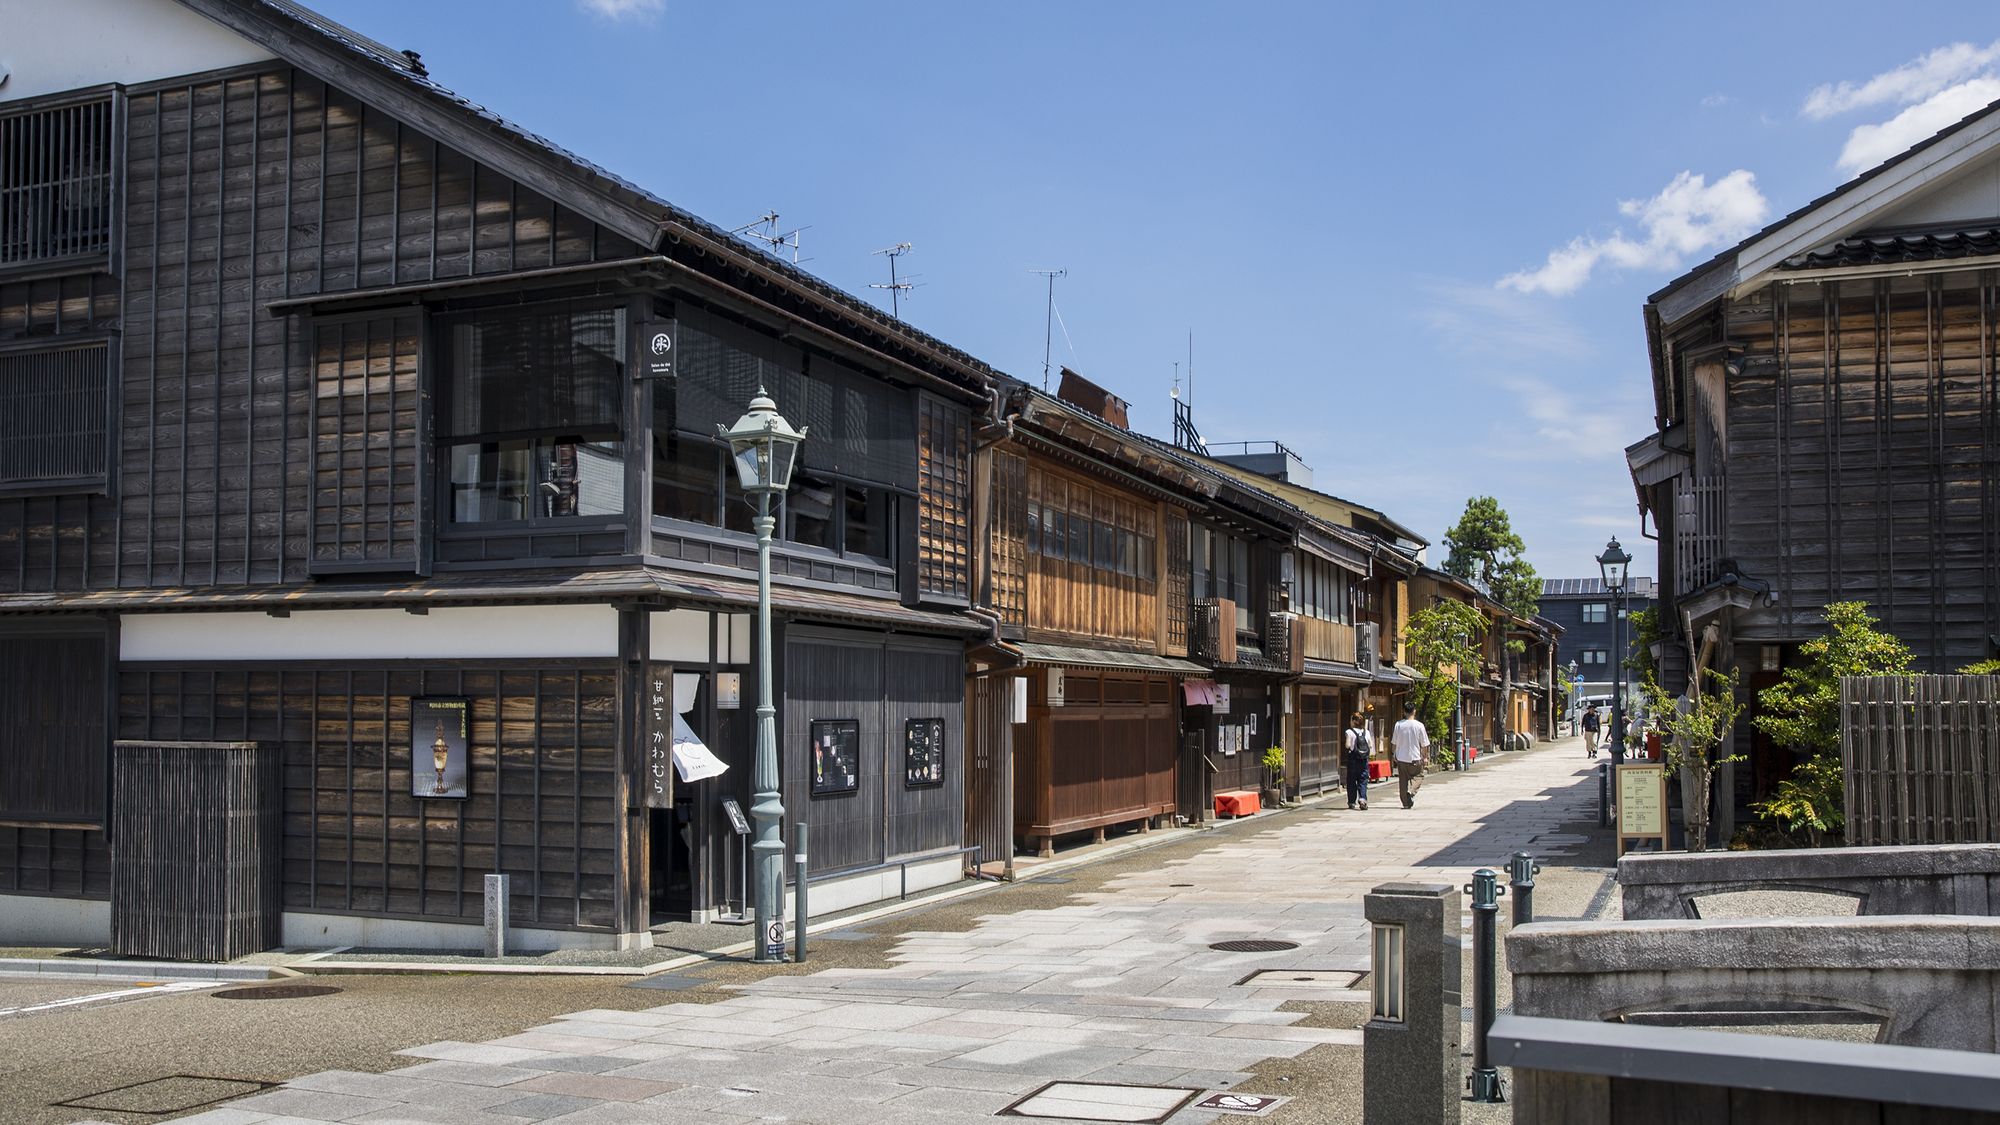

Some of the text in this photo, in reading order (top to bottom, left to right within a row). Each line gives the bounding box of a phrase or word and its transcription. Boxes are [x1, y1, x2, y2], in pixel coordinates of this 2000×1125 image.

[652, 679, 665, 794] 甘納豆 かわむら
